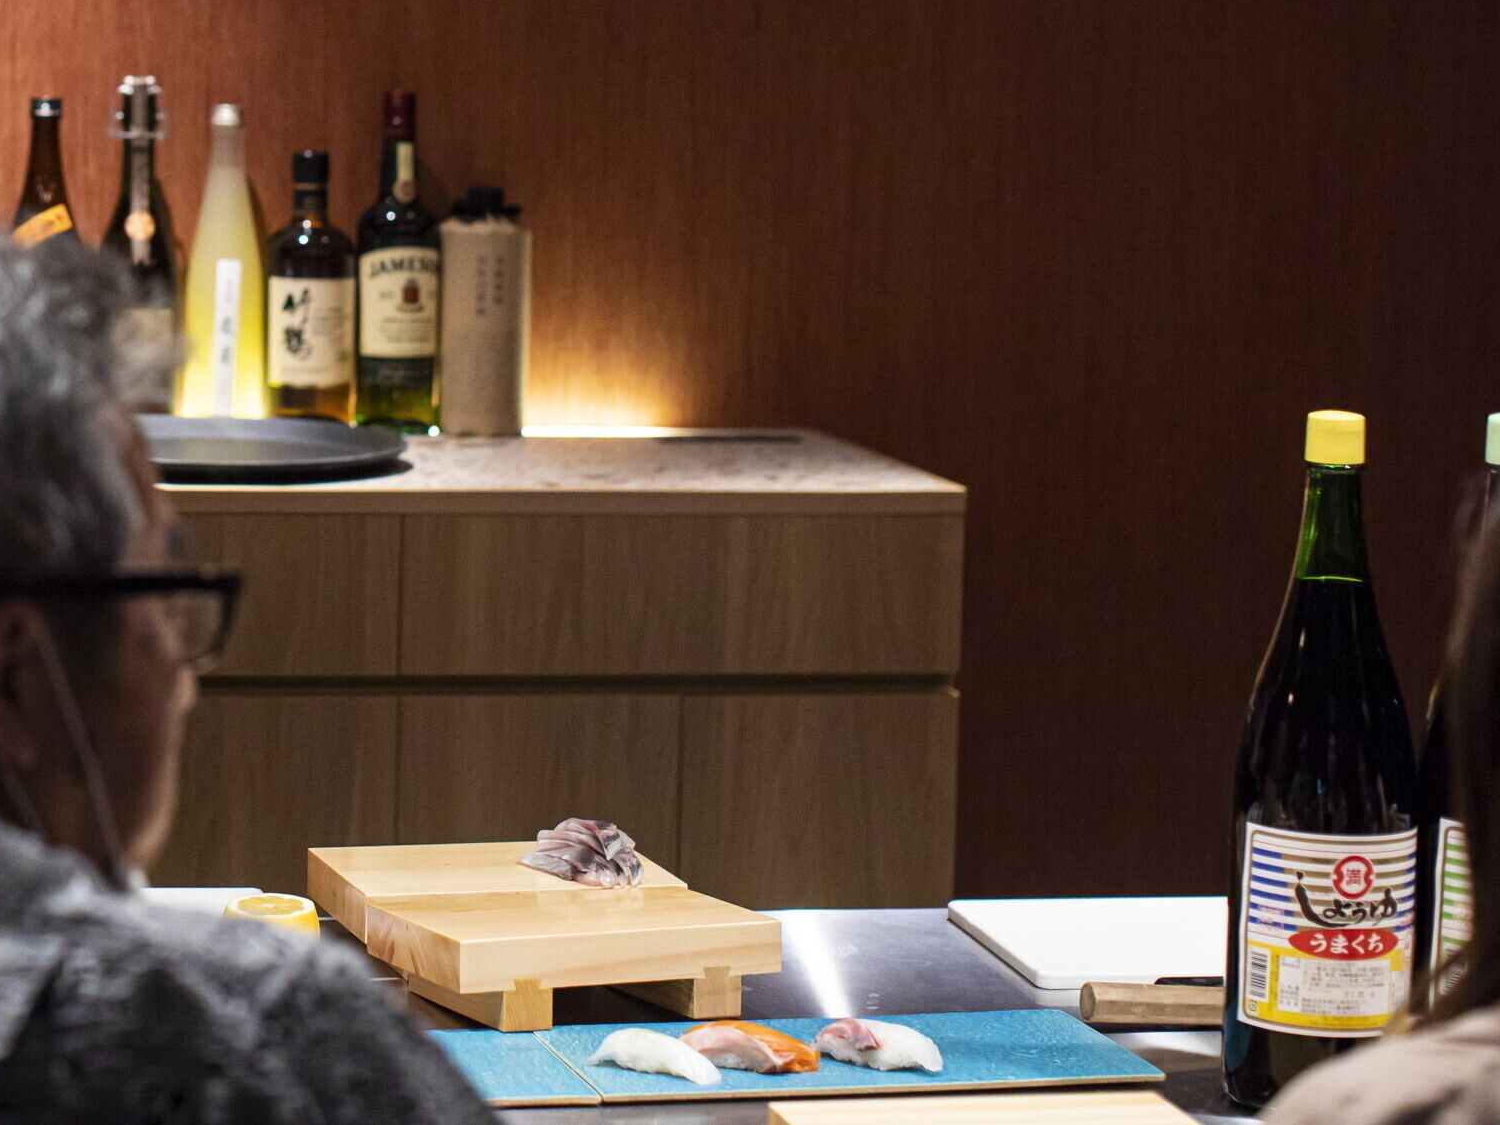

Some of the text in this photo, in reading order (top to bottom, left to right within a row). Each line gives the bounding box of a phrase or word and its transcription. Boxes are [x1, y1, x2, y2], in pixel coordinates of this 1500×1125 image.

[1295, 871, 1398, 928] しょうゆ
[1310, 933, 1385, 955] うまくち
